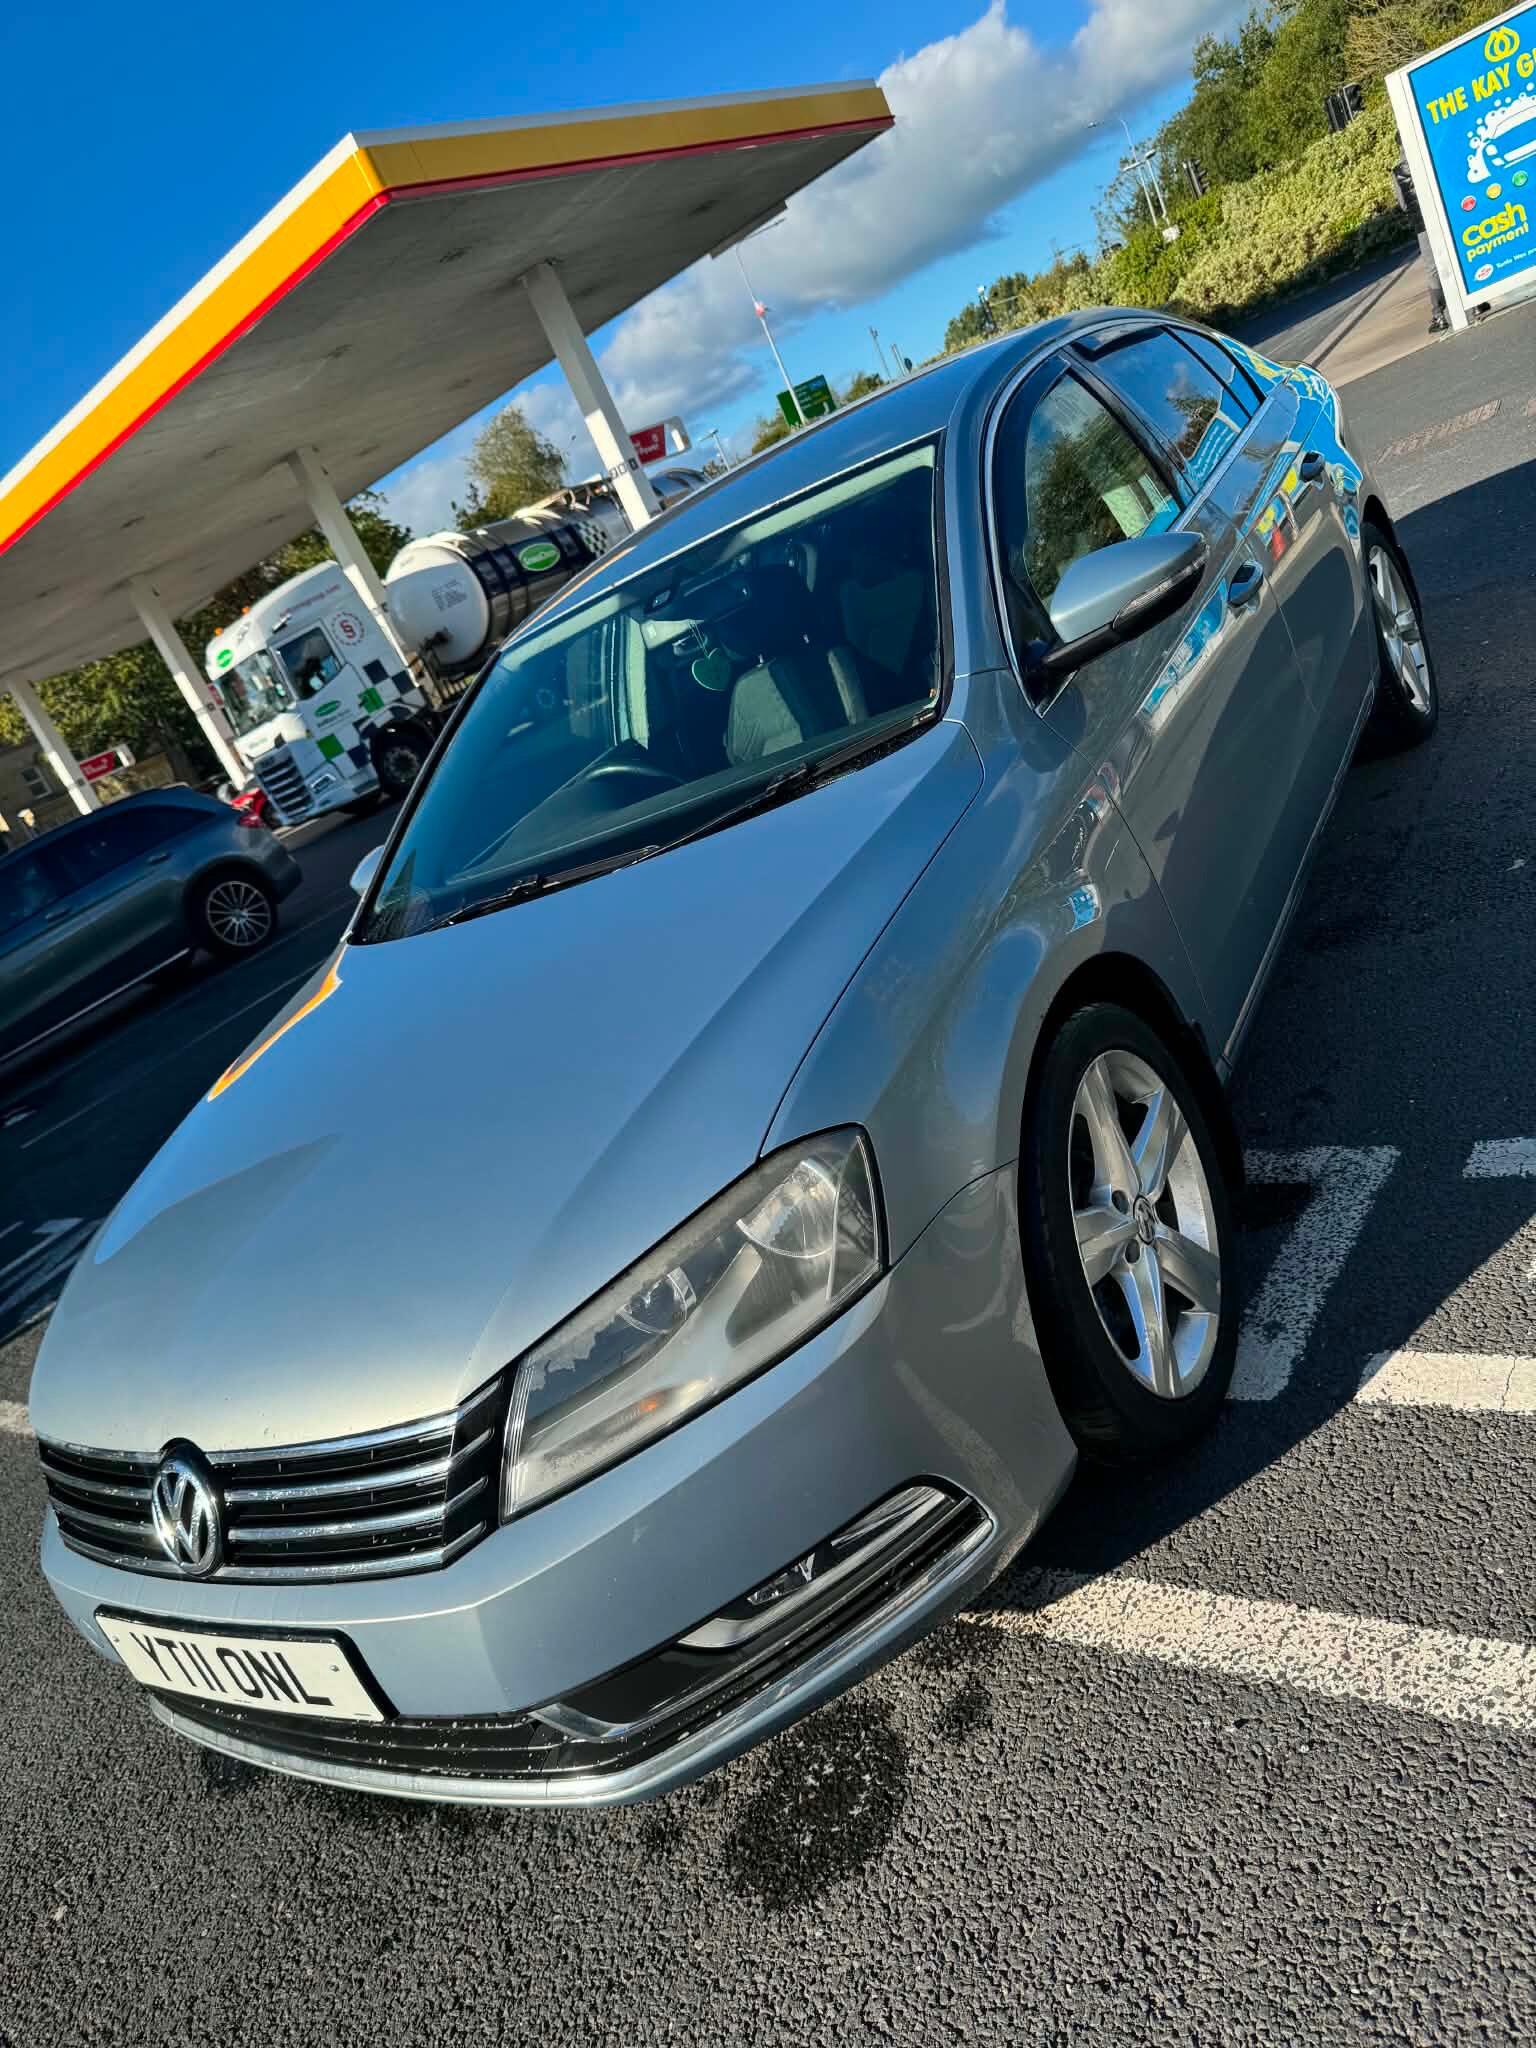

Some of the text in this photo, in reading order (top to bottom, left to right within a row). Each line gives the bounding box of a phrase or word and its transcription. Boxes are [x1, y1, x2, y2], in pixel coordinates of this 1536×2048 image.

[1426, 87, 1468, 124] THE
[1472, 62, 1510, 102] KAY
[1462, 202, 1527, 246] cash
[1466, 222, 1528, 262] payment
[130, 1631, 335, 1707] YT11 ONL
